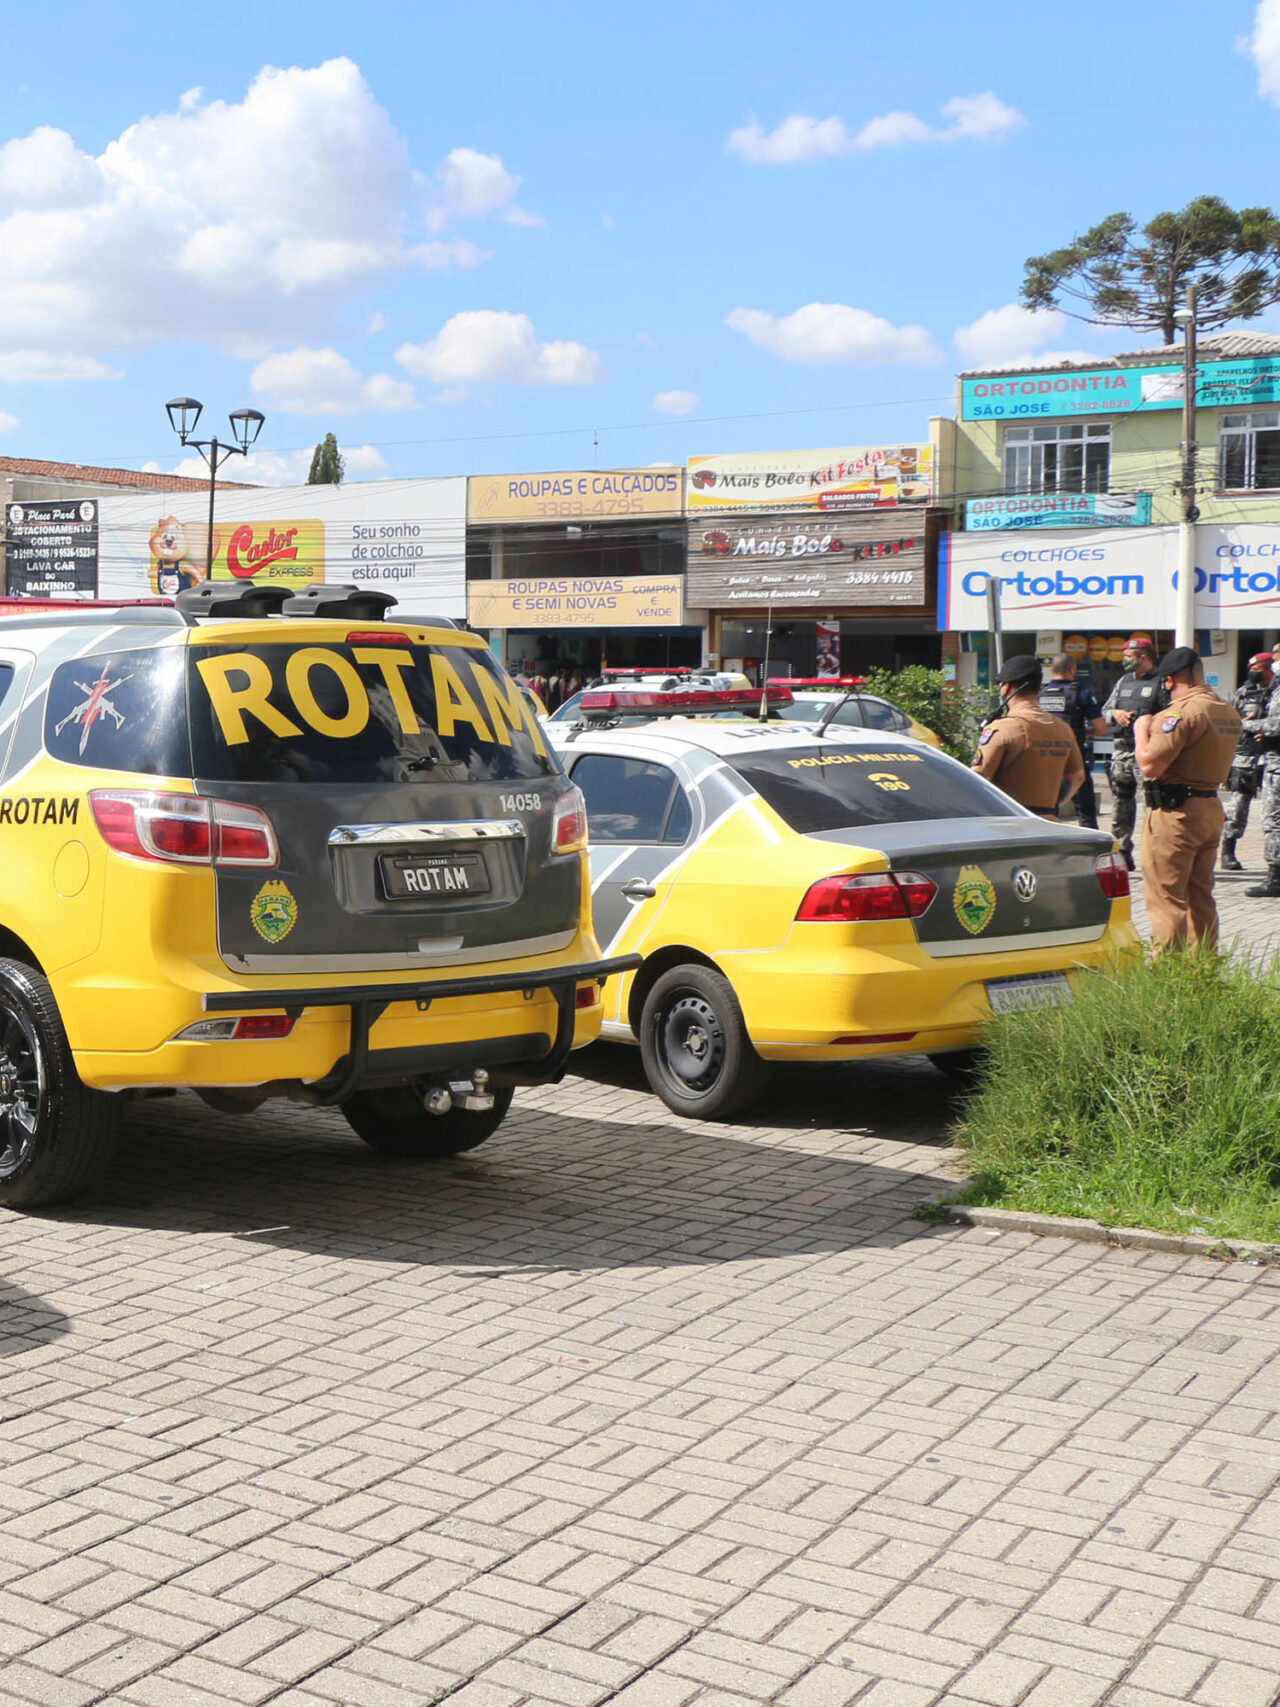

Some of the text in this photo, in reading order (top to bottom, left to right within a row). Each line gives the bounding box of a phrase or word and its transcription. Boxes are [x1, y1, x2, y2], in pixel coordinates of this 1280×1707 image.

[973, 374, 1128, 398] ORTODONTIA
[973, 404, 1005, 416] SÃO
[1011, 402, 1050, 415] JOSÉ
[719, 449, 884, 488] Mais Bolo Kit Festa
[509, 475, 677, 498] ROUPAS E CALÇADOS
[536, 499, 643, 517] 3383-4795
[972, 497, 1091, 515] ORTODONTIA
[27, 508, 75, 521] Place Park
[352, 523, 421, 539] Seu sonho
[31, 536, 72, 546] COBERTO
[733, 536, 786, 557] Mais
[792, 535, 844, 556] Bolo
[227, 524, 298, 579] Castor
[351, 542, 424, 559] de colchão
[1001, 547, 1106, 562] COLCHÕES
[26, 561, 76, 571] LAVA CAR
[269, 567, 314, 578] EXPRESS
[352, 563, 416, 582] está aqui!
[26, 581, 76, 591] BAIXINHO
[846, 572, 879, 585] 3384
[962, 570, 1144, 597] Ortobom
[508, 580, 623, 594] ROUPAS NOVAS
[632, 585, 677, 594] COMPRA
[513, 597, 617, 610] E SEMI NOVAS
[651, 597, 657, 605] E
[532, 613, 595, 623] 3383-4795
[637, 608, 672, 617] VENDE
[194, 647, 549, 757] ROTAM
[787, 752, 924, 769] POLÍCIA MILITAR
[875, 781, 912, 792] 190
[499, 793, 542, 812] 14058
[403, 867, 469, 892] ROTAM
